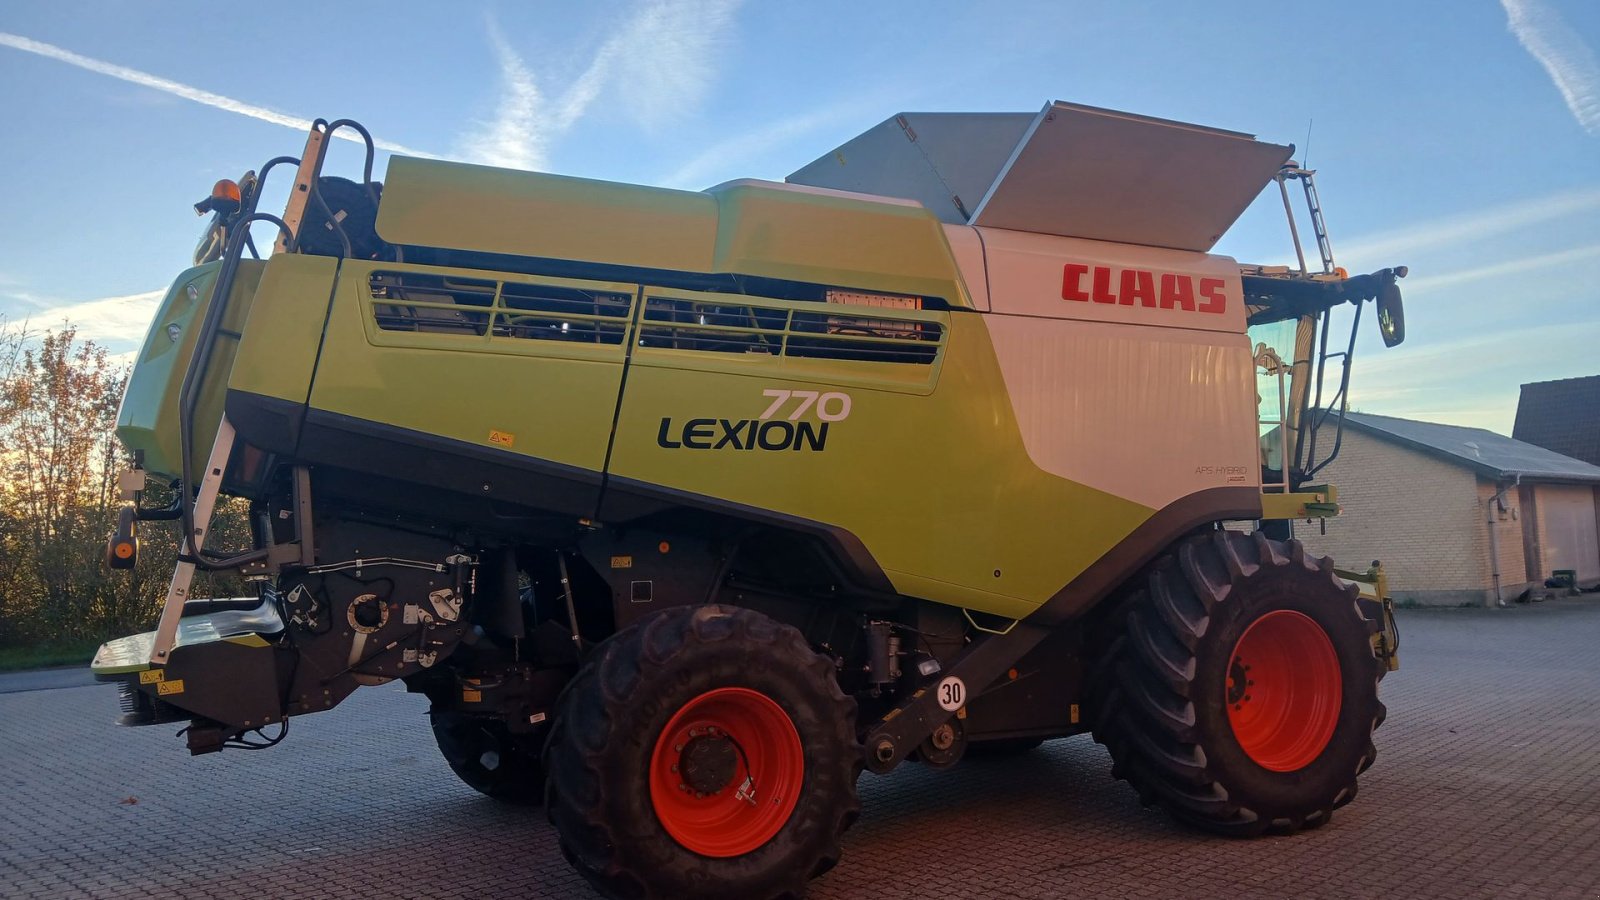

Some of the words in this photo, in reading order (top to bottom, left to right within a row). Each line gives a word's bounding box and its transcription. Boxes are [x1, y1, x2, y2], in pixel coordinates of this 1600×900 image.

[1062, 264, 1226, 314] CLAAS
[759, 389, 852, 421] 770
[657, 417, 829, 451] LEXION
[1195, 466, 1213, 475] APS
[942, 683, 961, 704] 30
